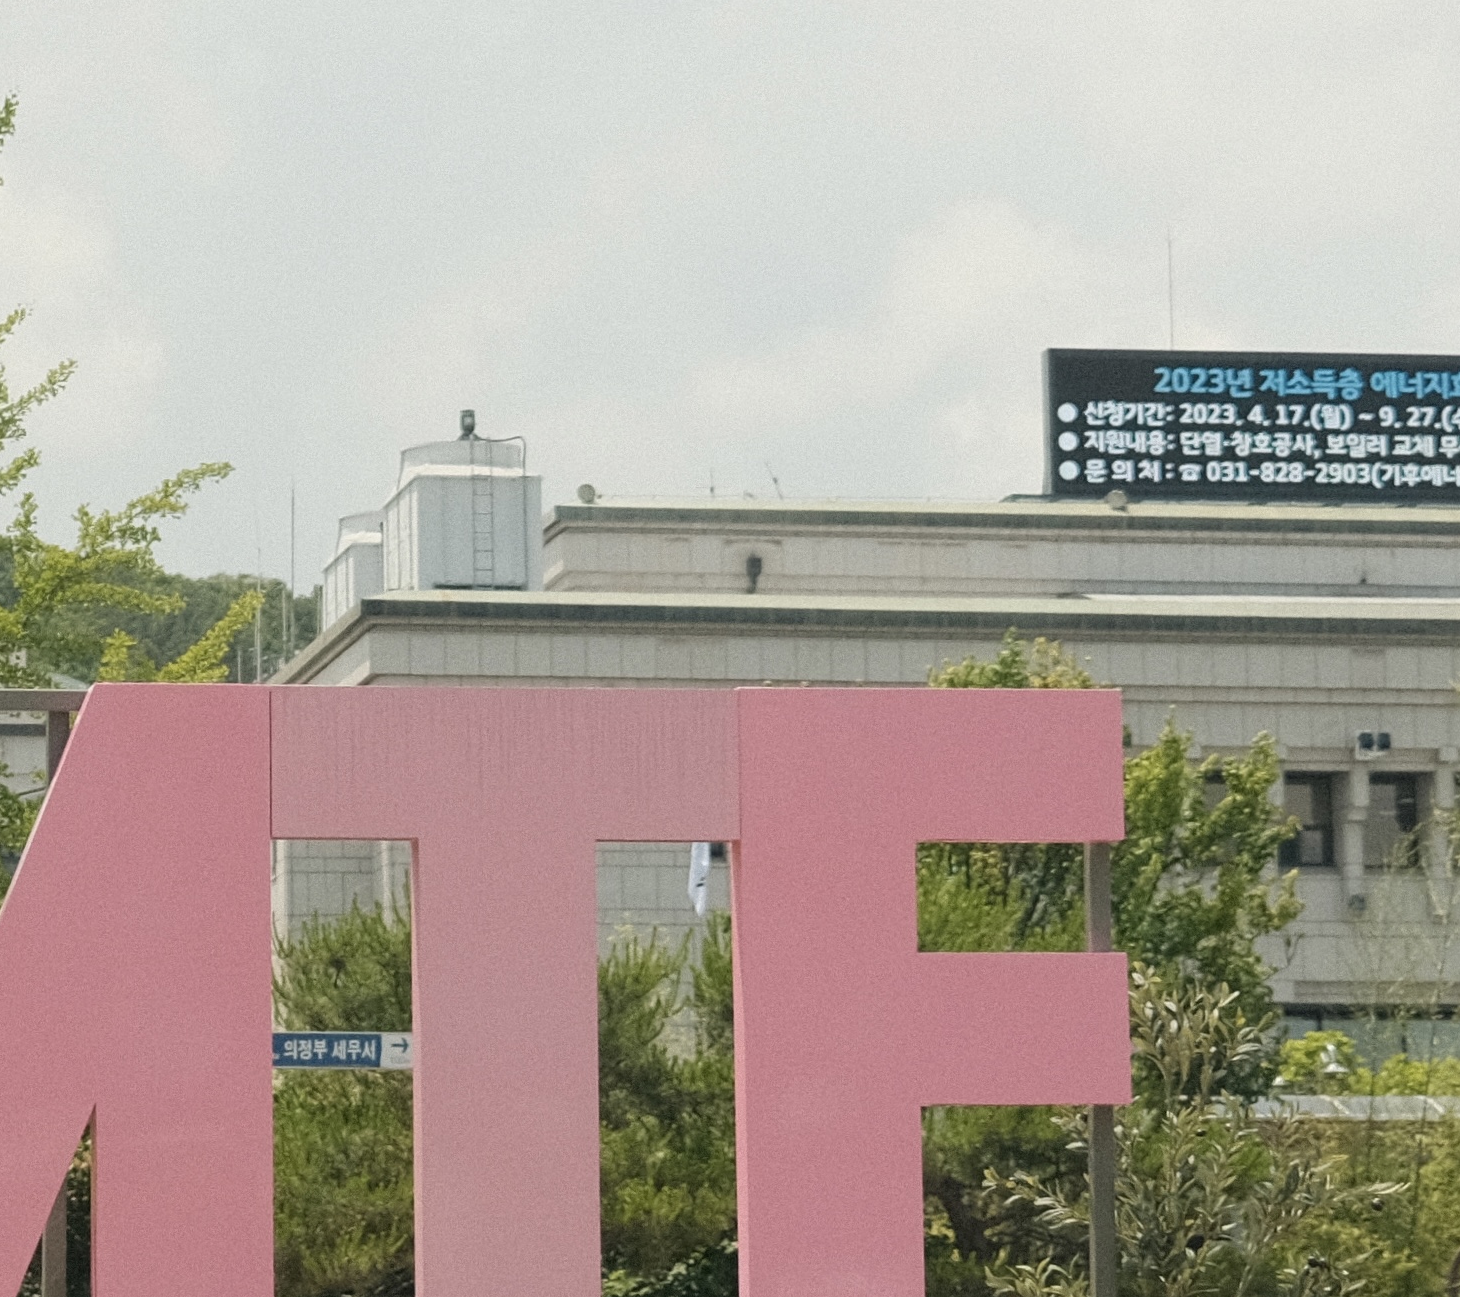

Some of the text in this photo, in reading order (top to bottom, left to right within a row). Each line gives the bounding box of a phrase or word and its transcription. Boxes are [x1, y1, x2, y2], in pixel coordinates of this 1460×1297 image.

[1153, 367, 1253, 398] 2023년
[1259, 368, 1363, 400] 저소득층
[1325, 433, 1389, 457] 보일러
[1393, 434, 1434, 457] 교체
[284, 1039, 376, 1060] 의정부 세무서
